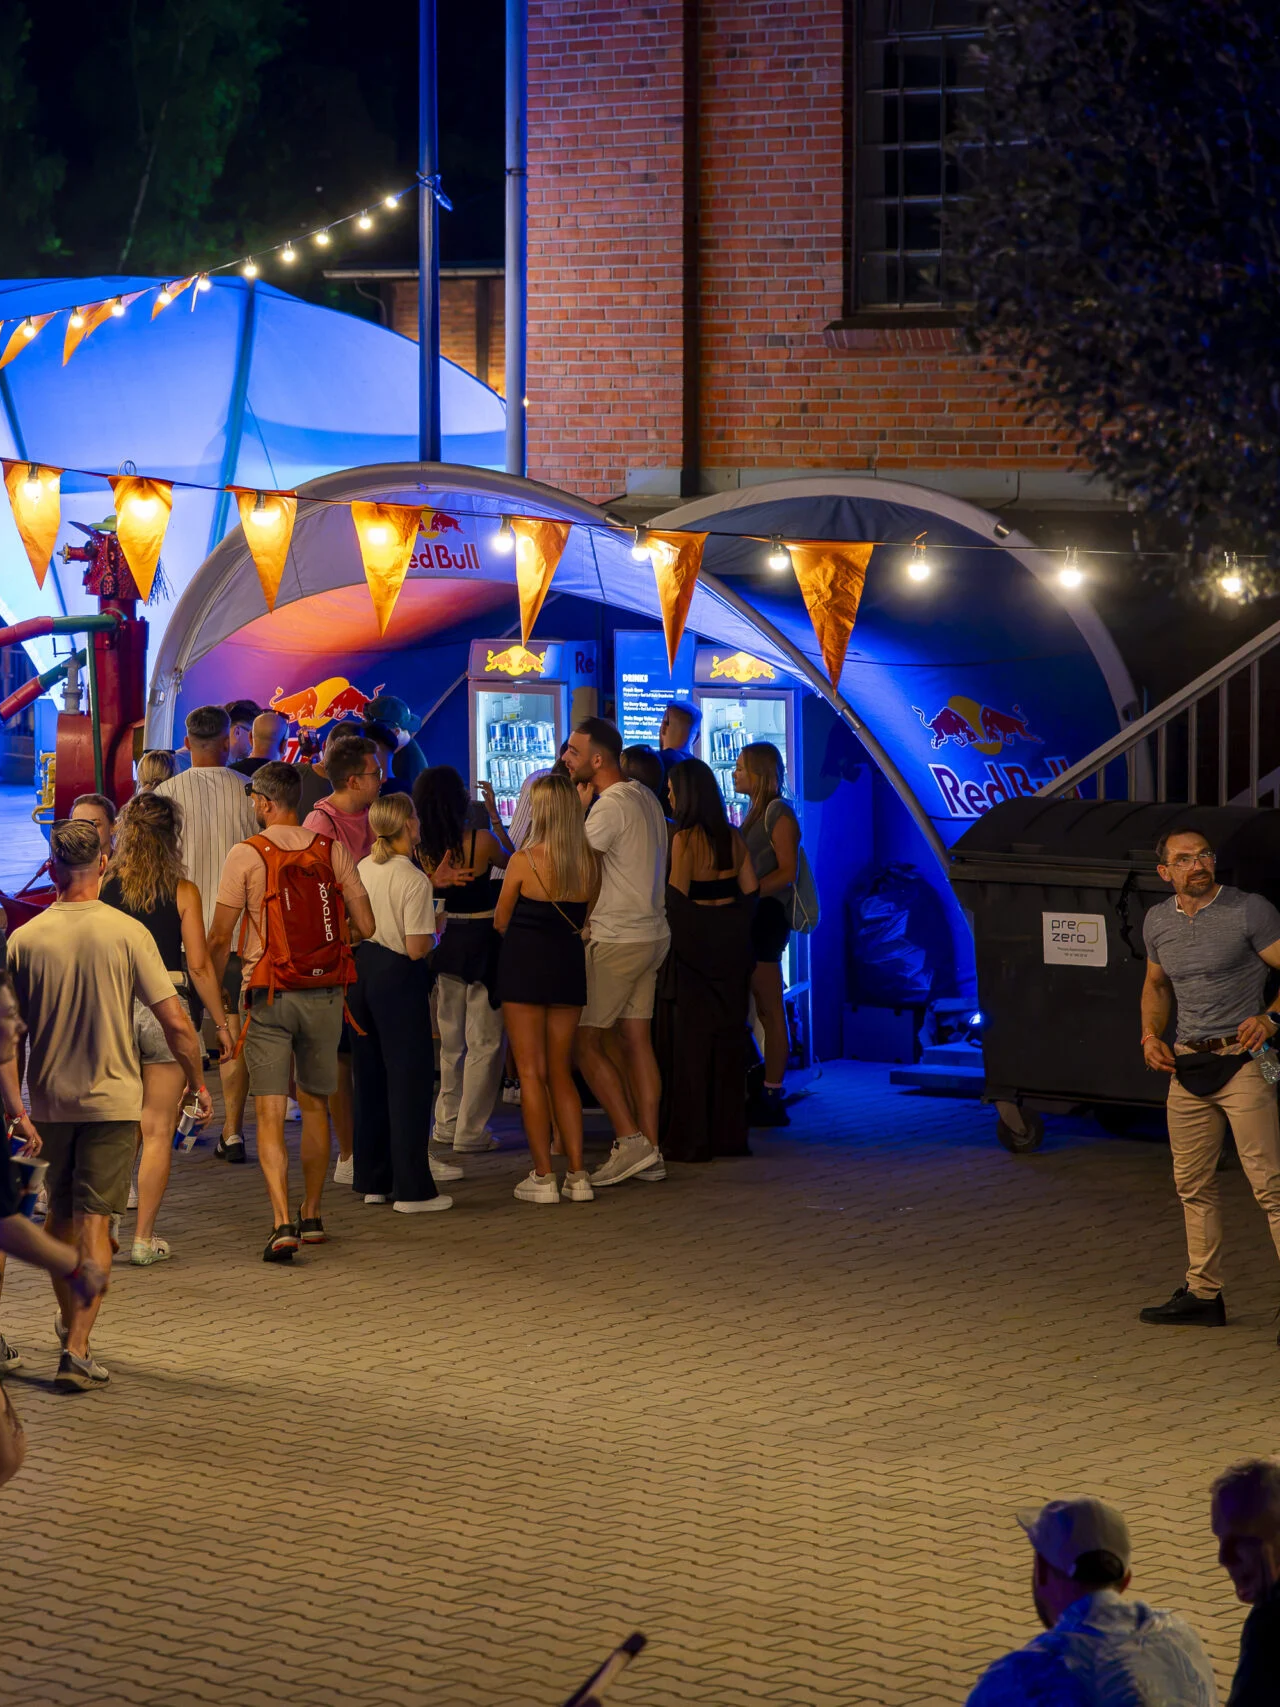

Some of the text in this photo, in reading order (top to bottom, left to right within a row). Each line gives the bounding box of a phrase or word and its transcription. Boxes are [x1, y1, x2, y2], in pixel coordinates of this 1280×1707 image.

[408, 543, 480, 570] ed Bull
[622, 673, 649, 683] DRINKS
[929, 762, 1008, 816] Red
[318, 882, 334, 941] ORTOVOX
[1051, 920, 1076, 931] pre
[1051, 933, 1086, 943] zero
